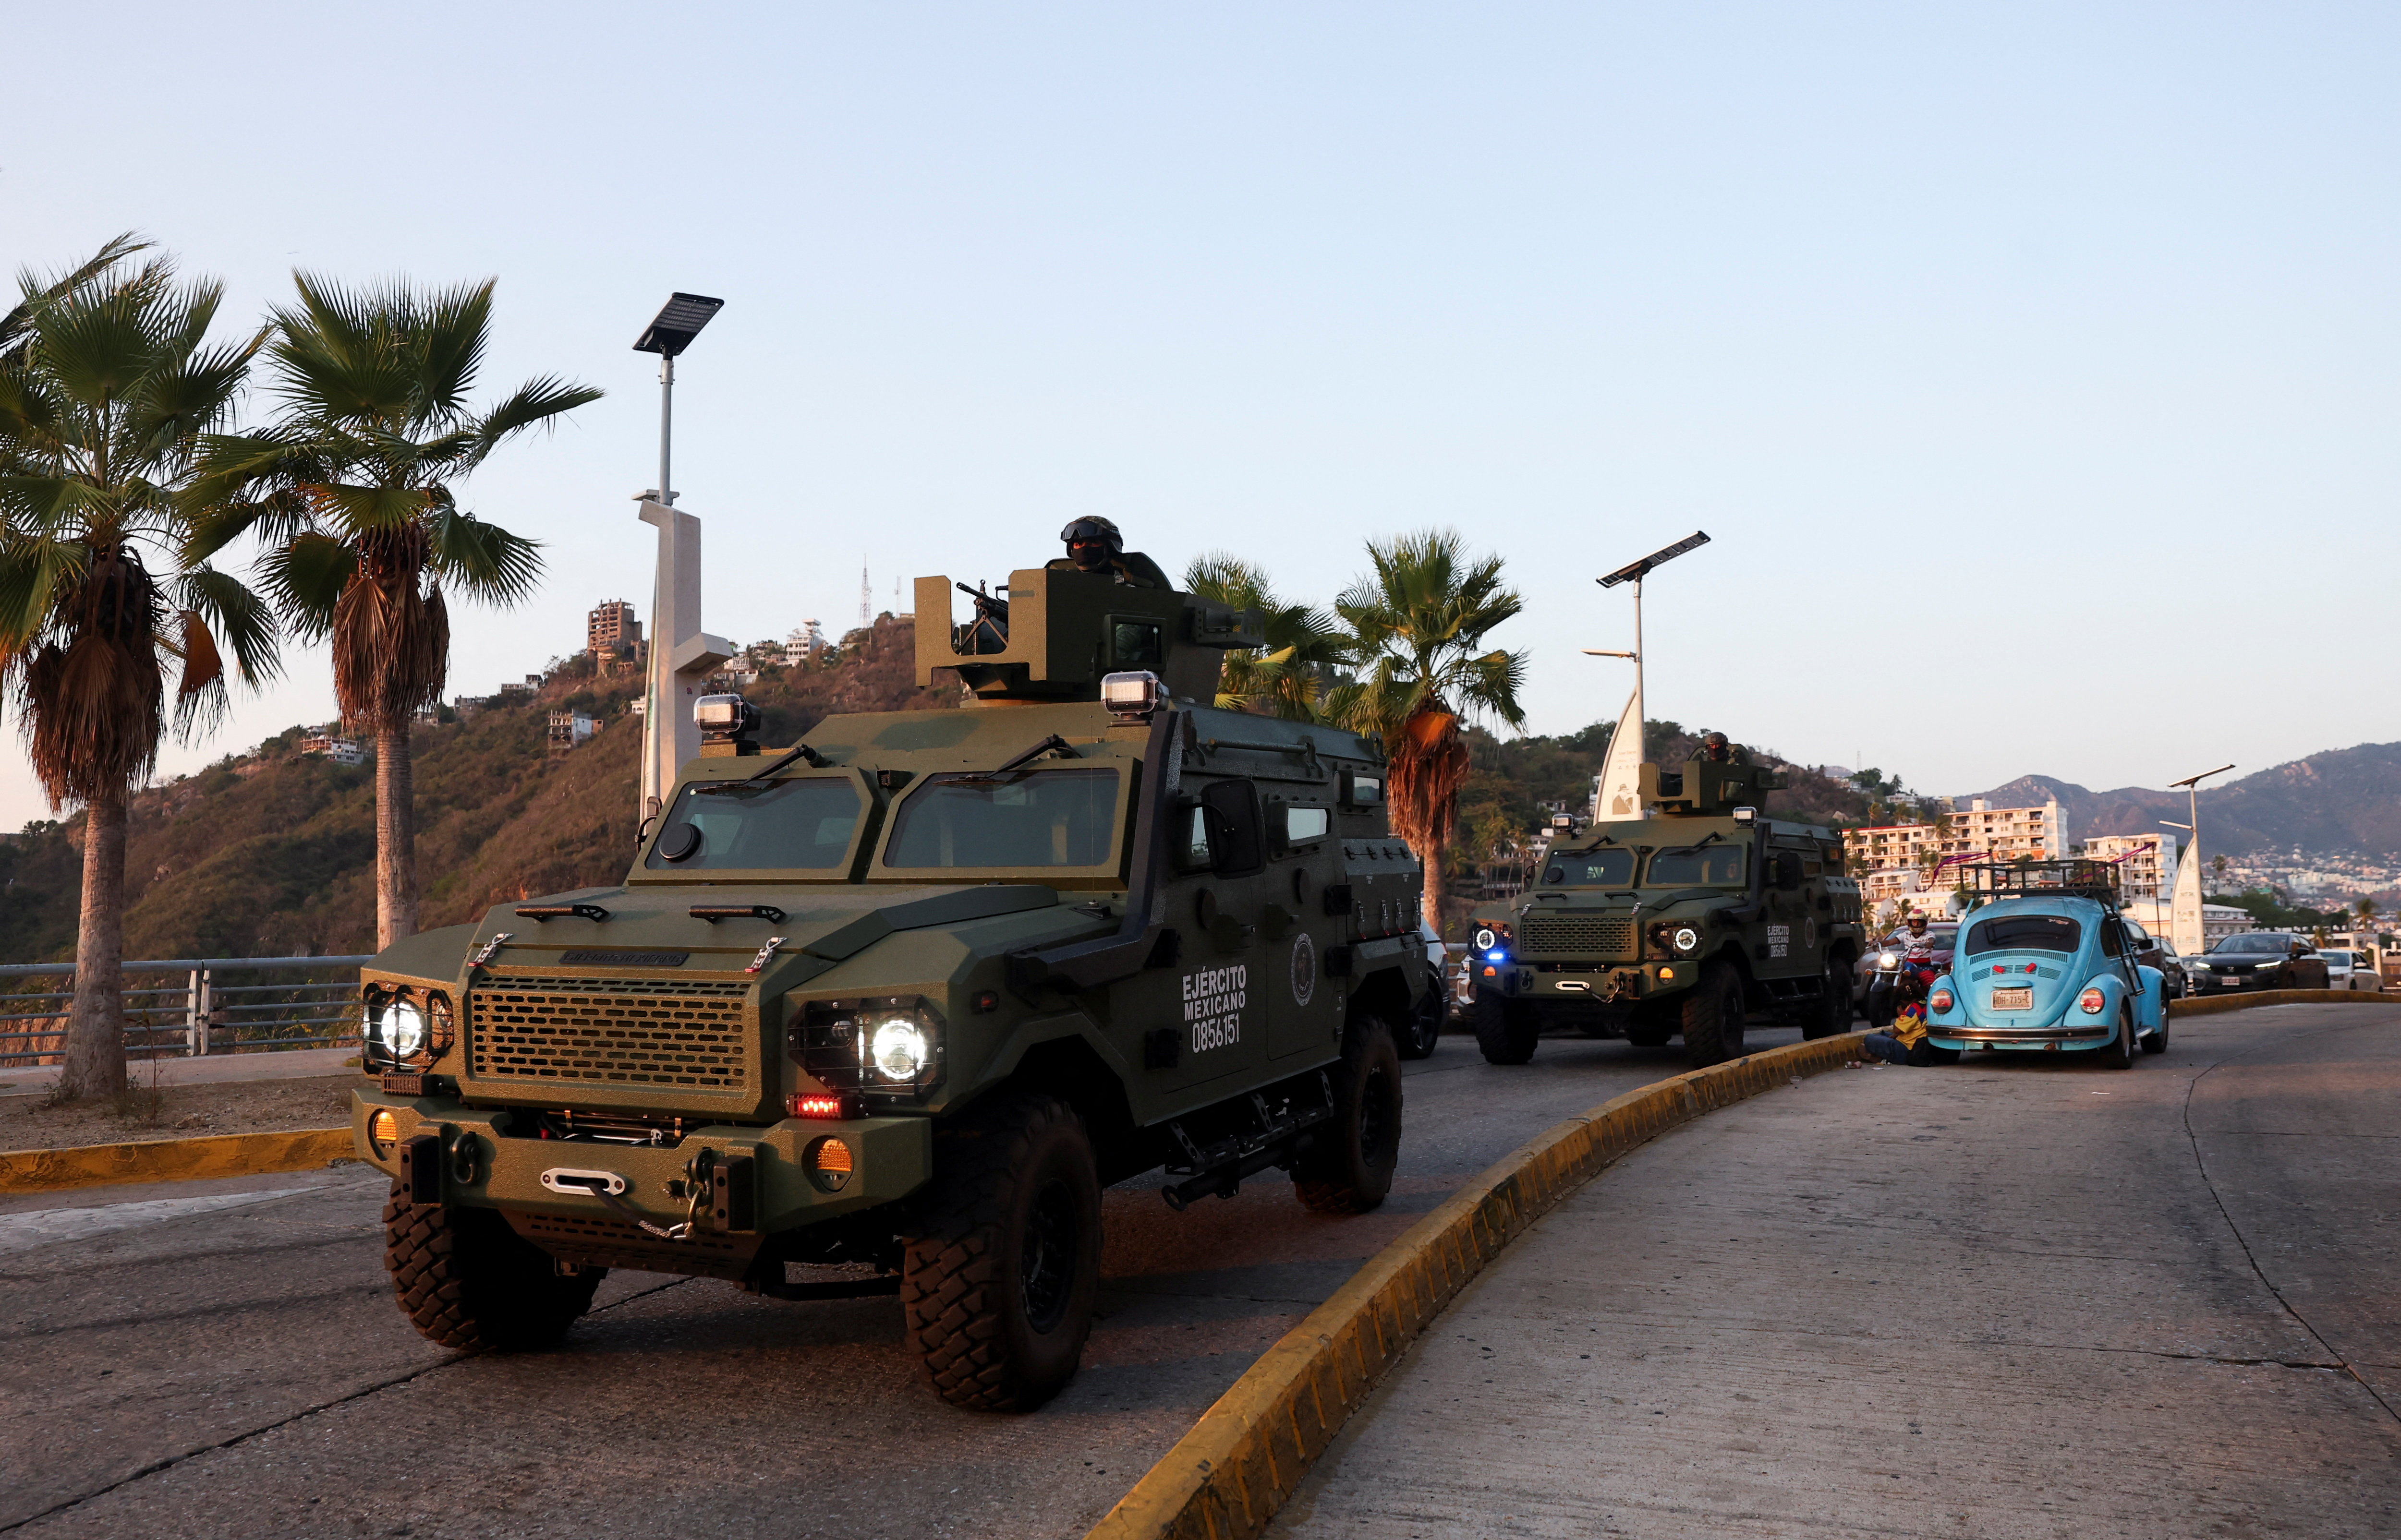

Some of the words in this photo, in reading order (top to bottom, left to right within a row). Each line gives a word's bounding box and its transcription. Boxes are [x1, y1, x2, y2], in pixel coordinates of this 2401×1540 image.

[1767, 924, 1789, 936] EJÉRCITO
[1183, 965, 1247, 1000] EJÉRCITO
[1184, 991, 1245, 1021] MEXICANO
[1192, 1013, 1239, 1053] 0856151
